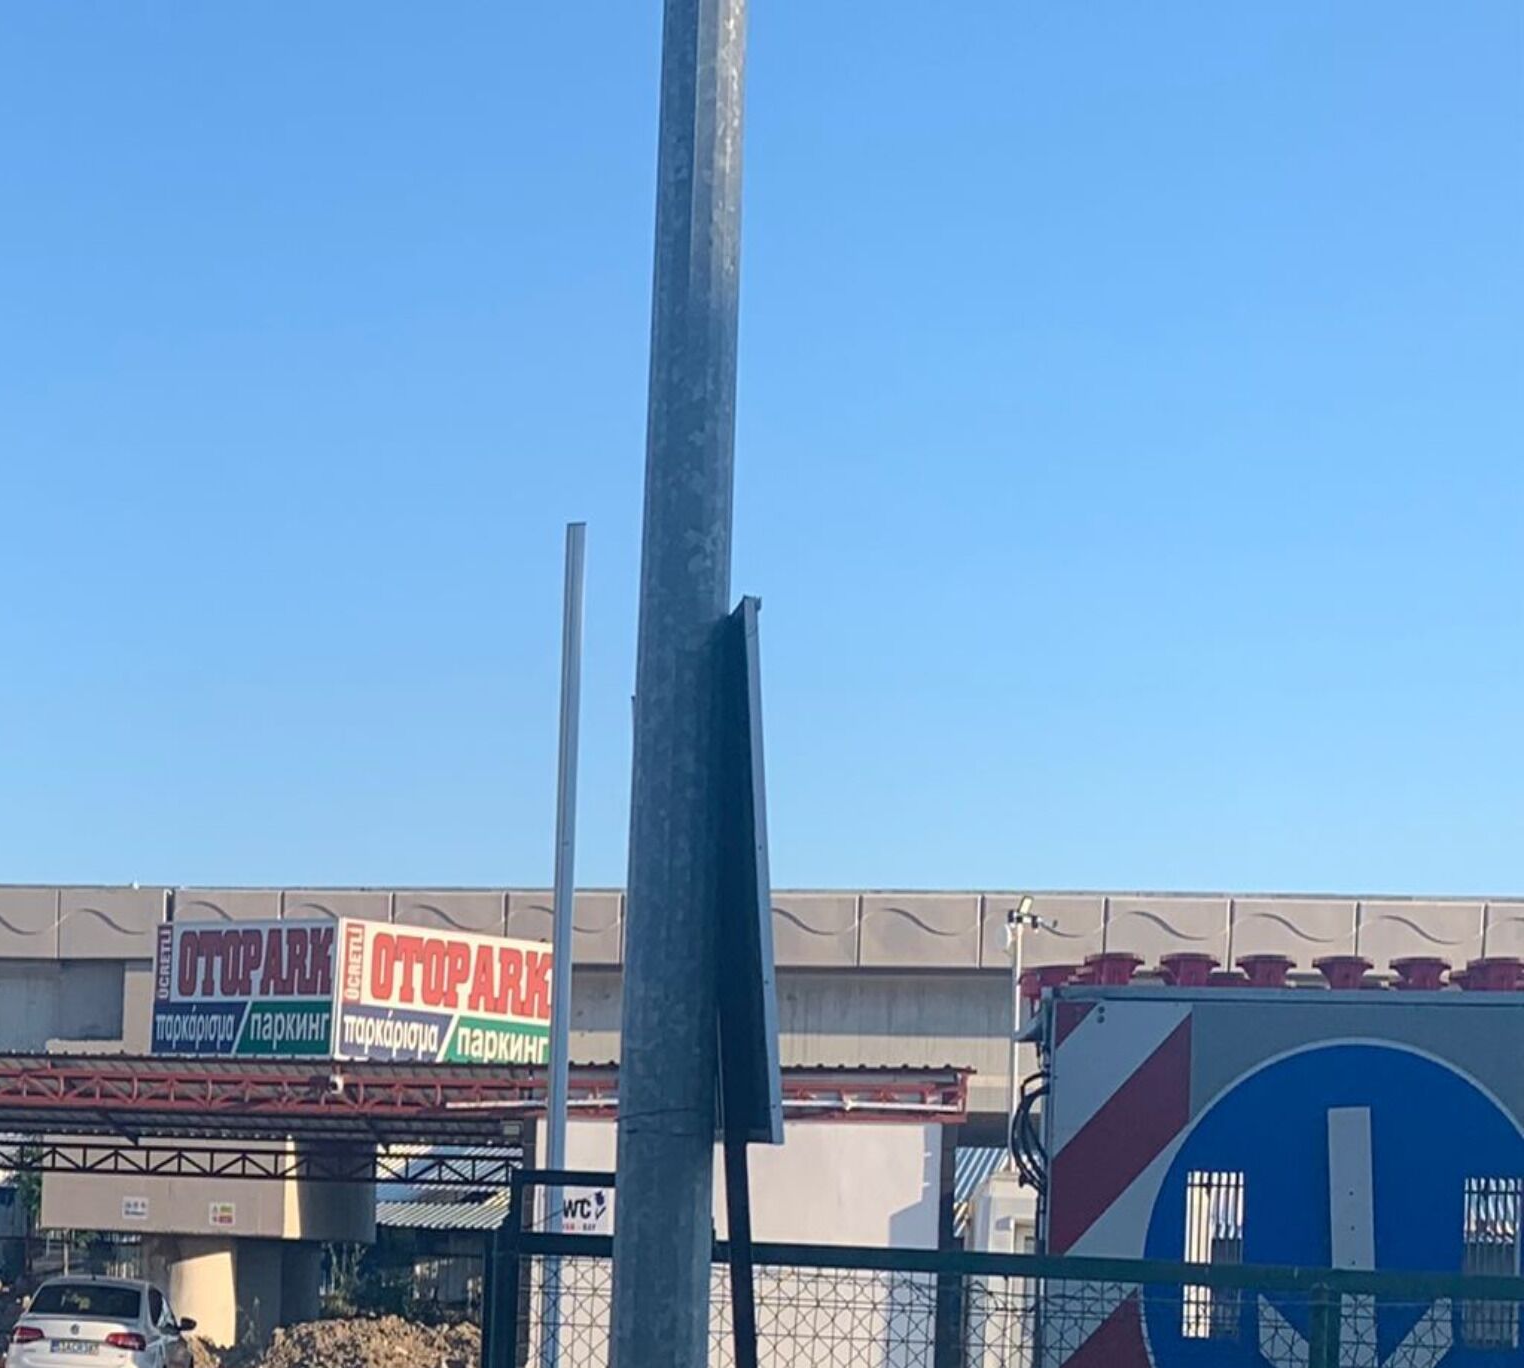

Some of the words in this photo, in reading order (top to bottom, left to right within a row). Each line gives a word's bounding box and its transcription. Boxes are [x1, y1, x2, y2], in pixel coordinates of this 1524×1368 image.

[178, 925, 334, 997] OTOPARK
[370, 931, 552, 1020] OTOPARK
[250, 1009, 329, 1054] паркинг
[457, 1026, 549, 1063] паркинг
[563, 1198, 592, 1219] WC
